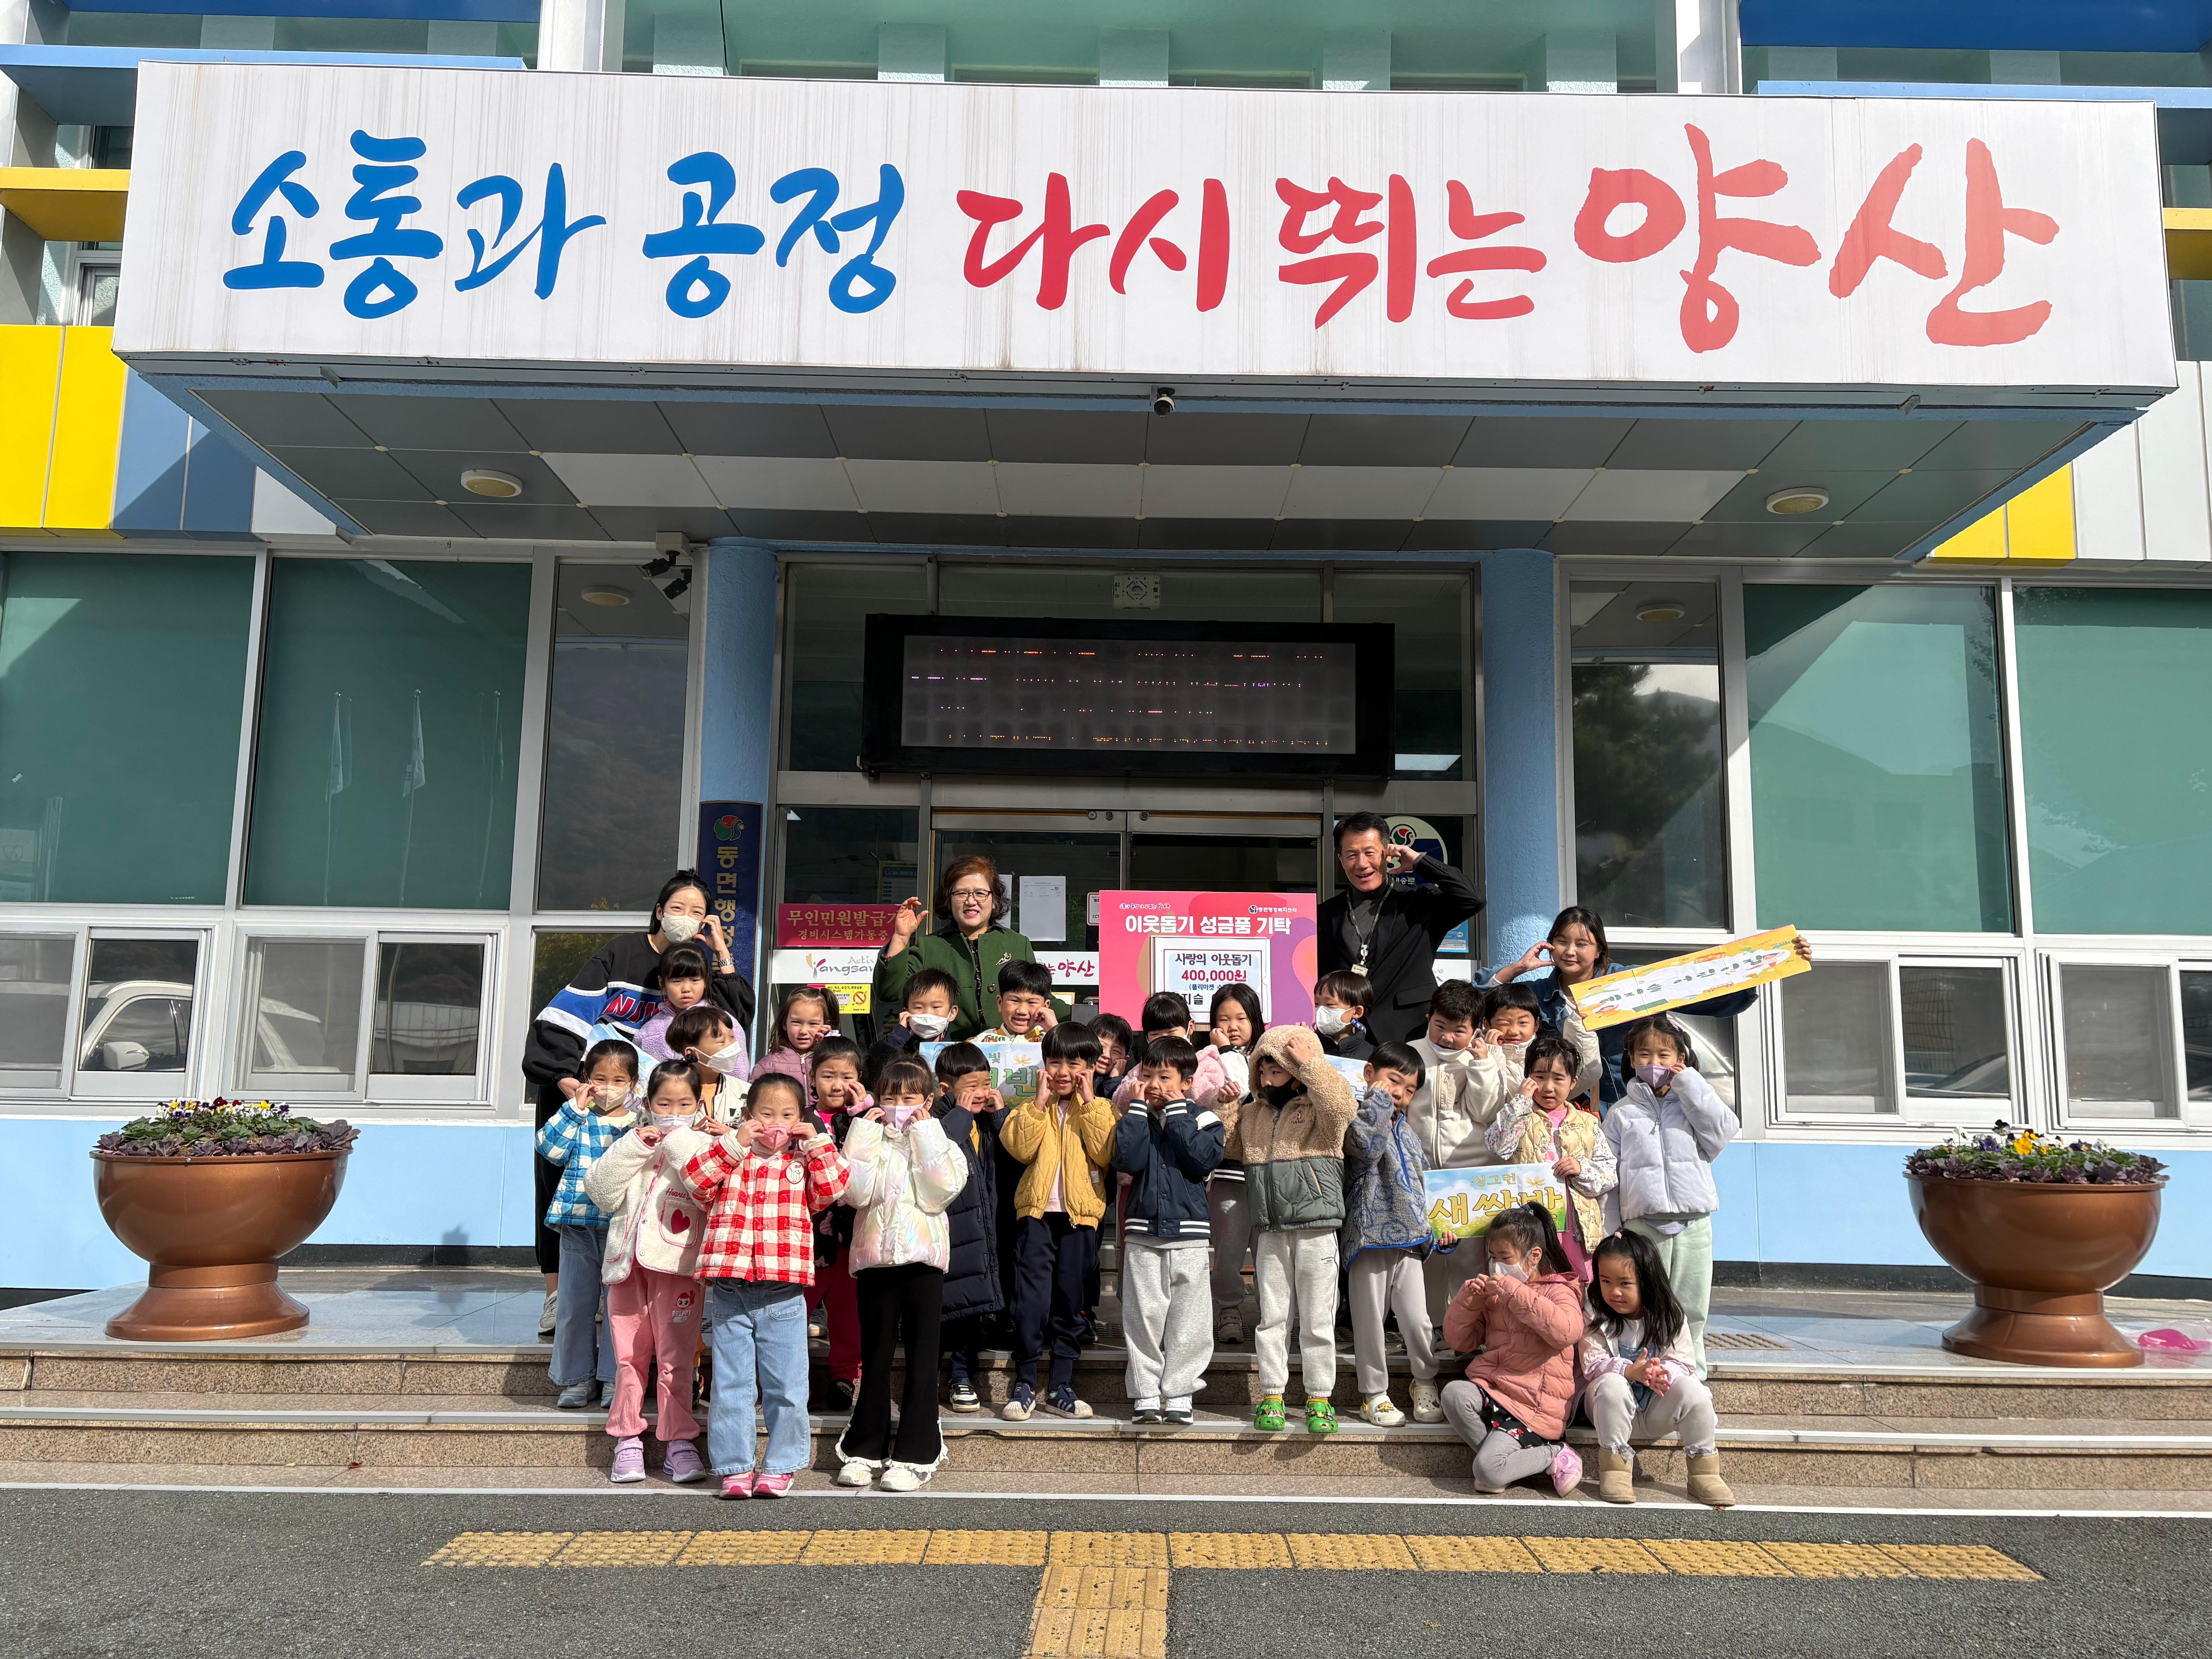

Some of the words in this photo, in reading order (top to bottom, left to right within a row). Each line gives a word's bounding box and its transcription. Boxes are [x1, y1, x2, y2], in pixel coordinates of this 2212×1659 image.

[223, 130, 606, 319] 소통과
[643, 151, 905, 318] 공정
[956, 172, 1230, 313] 다시
[1275, 173, 1547, 330] 뛰는
[1574, 123, 2059, 354] 양산
[1125, 915, 1194, 934] 이웃돕기
[1200, 917, 1251, 934] 성금품
[1257, 917, 1291, 934] 기탁
[798, 929, 888, 941] 경비시스템가동중
[1175, 953, 1206, 966] 사랑의
[1211, 953, 1252, 966] 이웃돕기
[1058, 959, 1095, 977] 양산
[1673, 955, 1762, 984] 어린이집
[1182, 970, 1247, 982] 400,000원
[1181, 993, 1204, 1005] 지슬
[1472, 1173, 1516, 1187] 싱그런
